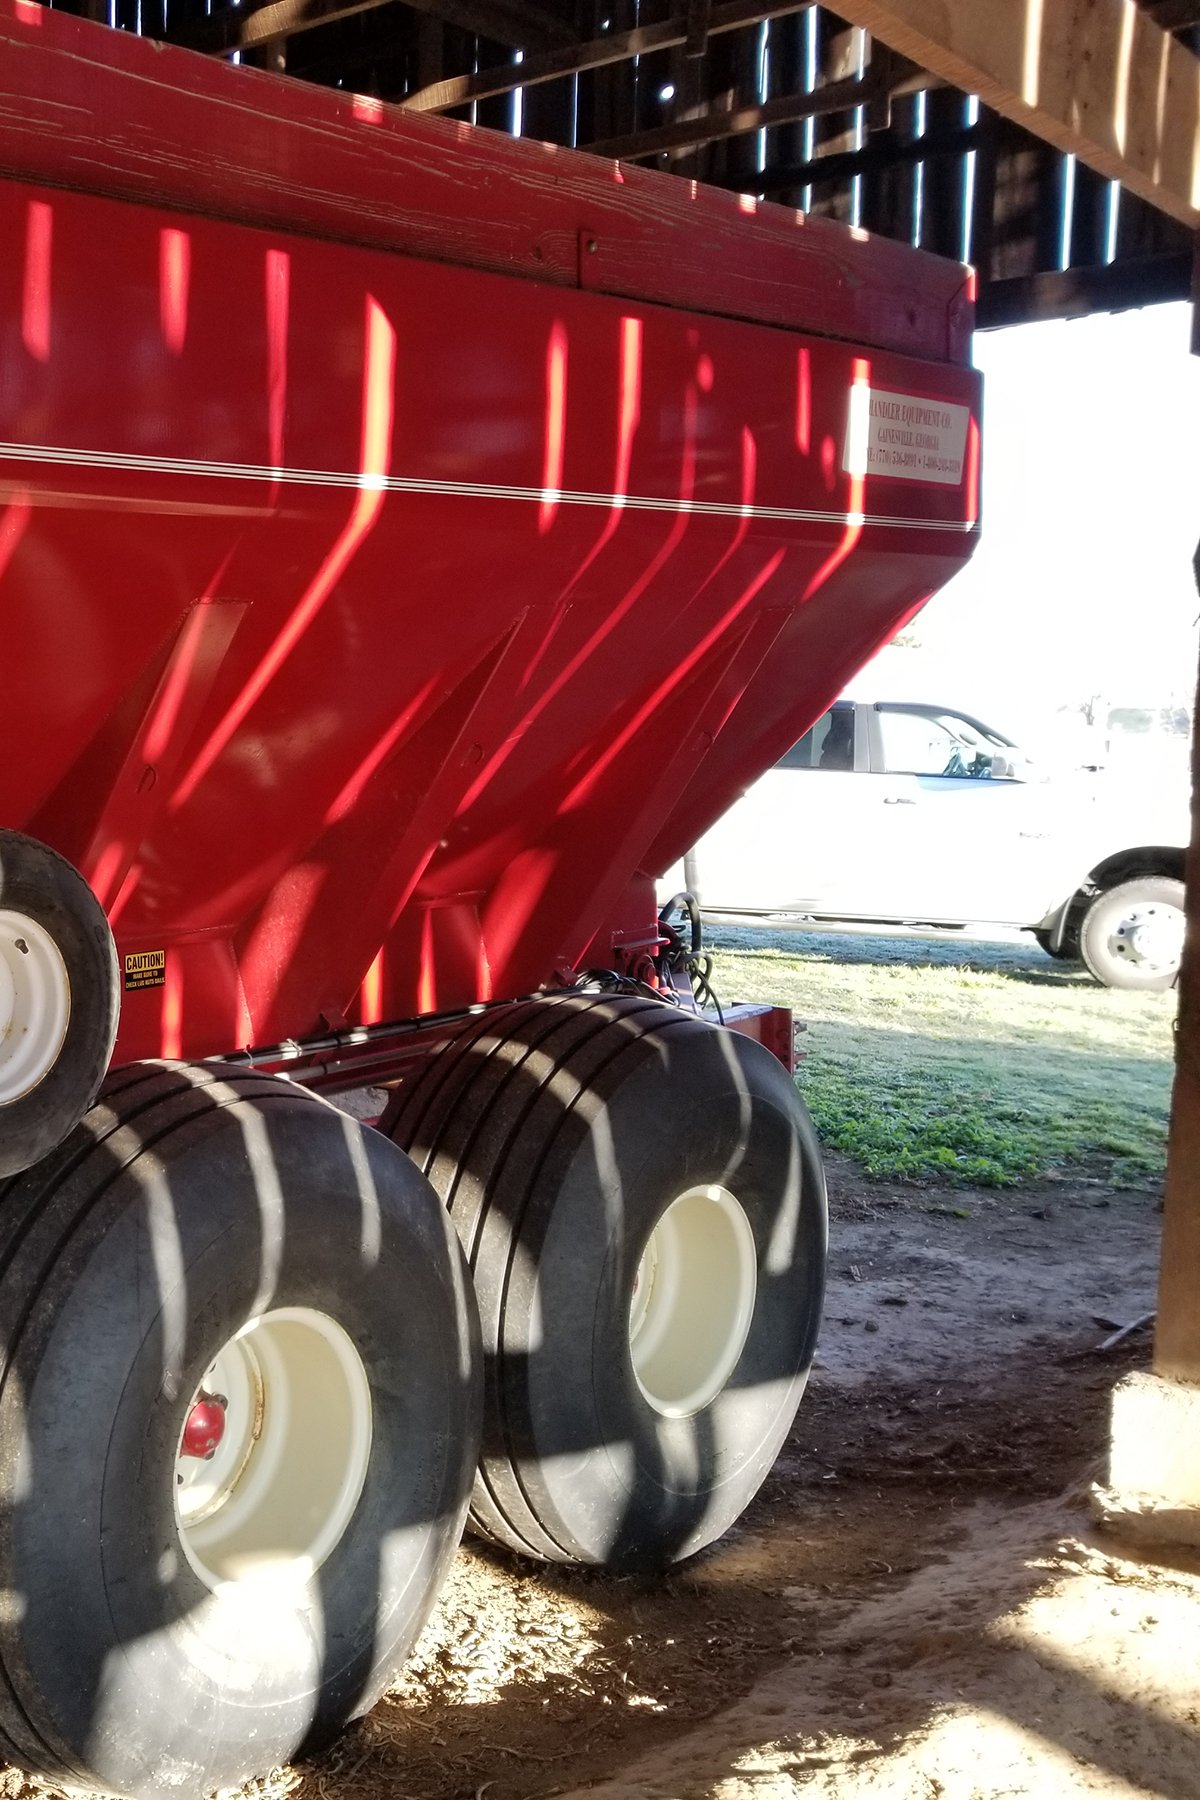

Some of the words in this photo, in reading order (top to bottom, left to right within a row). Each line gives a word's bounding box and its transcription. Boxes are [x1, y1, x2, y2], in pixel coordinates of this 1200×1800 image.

[869, 399, 900, 421] HANDLER
[901, 405, 940, 428] EQUIPMENT
[127, 953, 163, 970] CAUTION!
